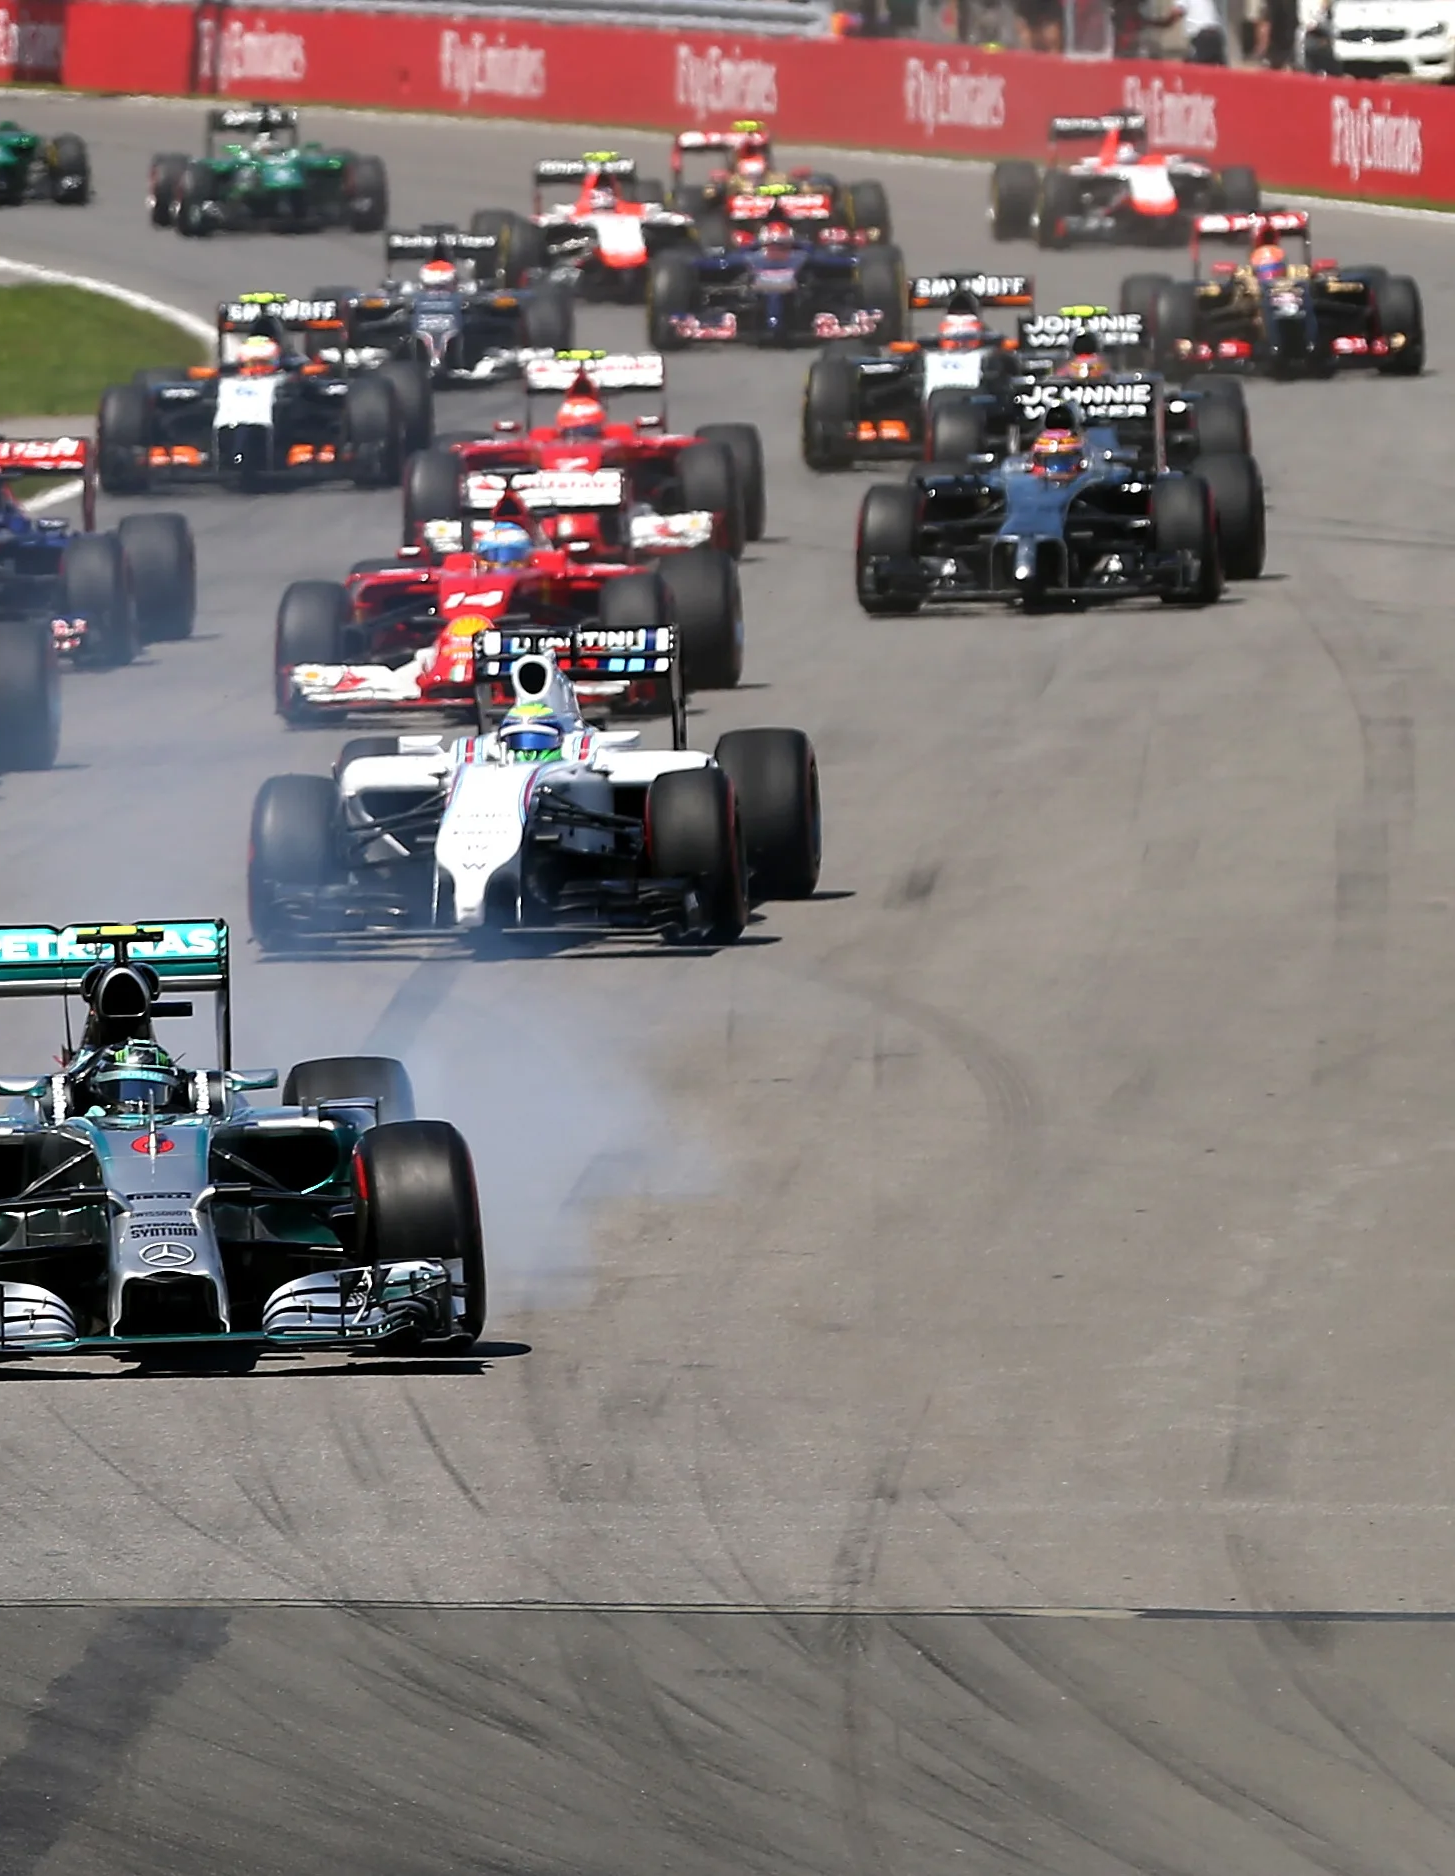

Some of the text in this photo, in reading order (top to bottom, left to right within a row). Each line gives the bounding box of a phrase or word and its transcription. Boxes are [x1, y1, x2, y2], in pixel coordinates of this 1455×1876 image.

[227, 300, 337, 321] SMRNOFF
[1028, 332, 1140, 347] WAER
[1024, 404, 1147, 420] WKER
[443, 588, 504, 610] 14
[131, 1228, 198, 1239] SYNTIUM
